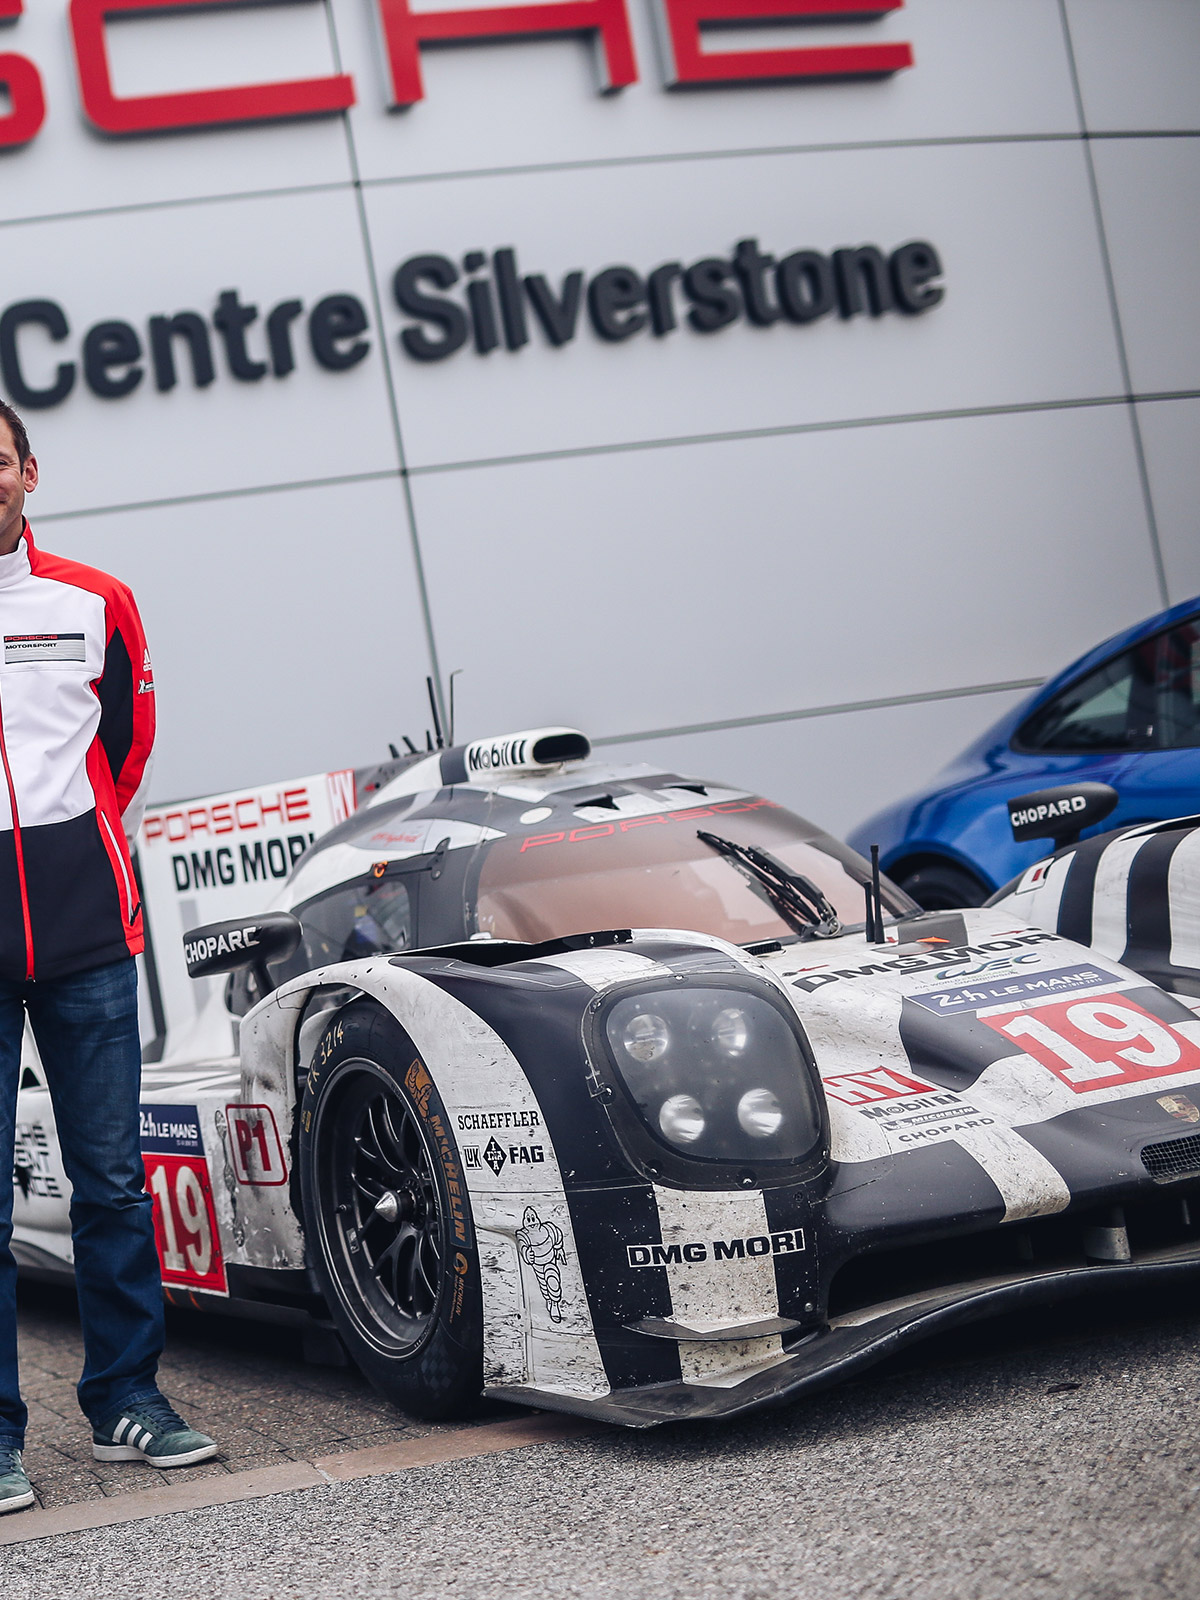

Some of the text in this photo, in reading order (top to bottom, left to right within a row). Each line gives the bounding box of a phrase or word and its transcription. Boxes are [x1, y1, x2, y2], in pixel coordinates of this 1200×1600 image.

[393, 237, 946, 364] Silverstone
[5, 642, 58, 650] MOTORSPORT
[469, 742, 510, 771] Mobil
[143, 787, 311, 847] PORSCHE
[1010, 795, 1087, 827] CHOPARD
[172, 847, 236, 891] DMG
[791, 933, 1062, 993] DMG MOR
[989, 985, 1024, 997] LE
[1024, 971, 1100, 991] MANS
[1000, 1001, 1182, 1084] 19
[457, 1110, 540, 1131] SCHAEFFLER
[859, 1099, 936, 1120] Mobil
[911, 1106, 975, 1125] MICHELIN
[157, 1122, 170, 1138] LE
[170, 1122, 198, 1139] MANS
[234, 1119, 272, 1172] P1
[898, 1117, 996, 1143] CHOPARD
[508, 1145, 545, 1165] FAG
[429, 1114, 467, 1243] MICHELIN
[151, 1164, 213, 1277] 19
[628, 1229, 804, 1266] DMG MORI
